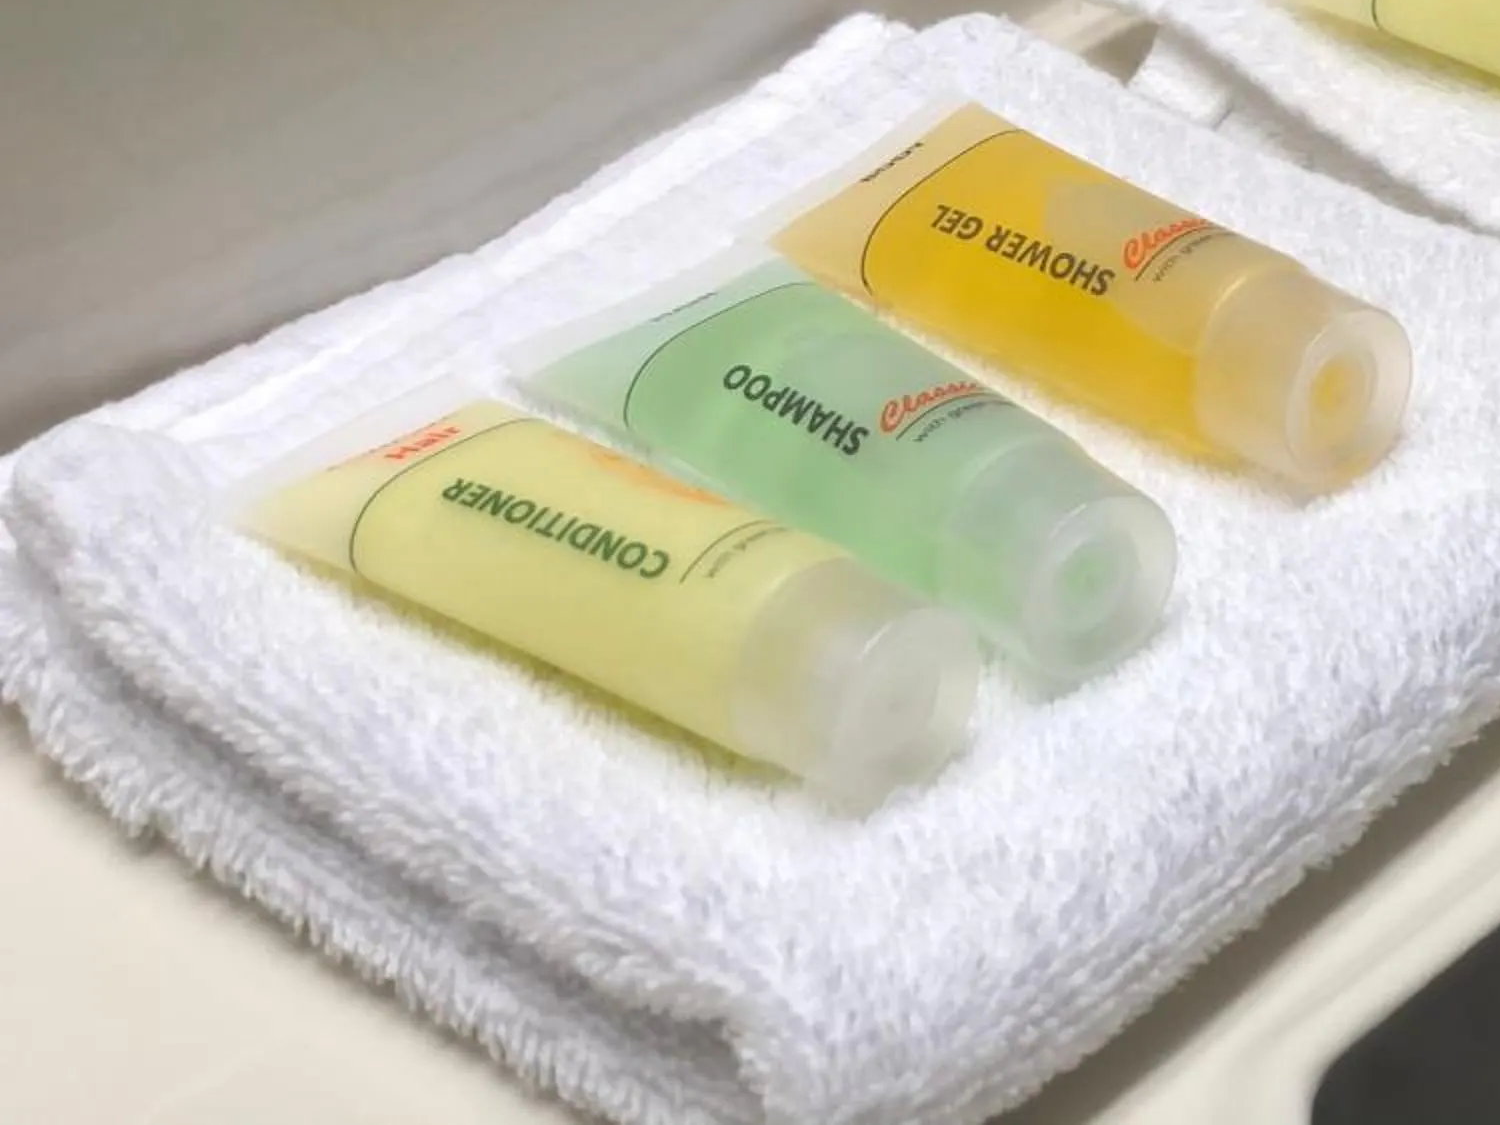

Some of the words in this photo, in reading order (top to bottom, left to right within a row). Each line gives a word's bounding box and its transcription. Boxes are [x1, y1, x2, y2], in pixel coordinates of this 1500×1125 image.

[930, 203, 984, 241] GEL
[985, 224, 1116, 296] SHOWER
[722, 364, 870, 456] SHAMPOO
[441, 477, 671, 579] CONDITIONER
